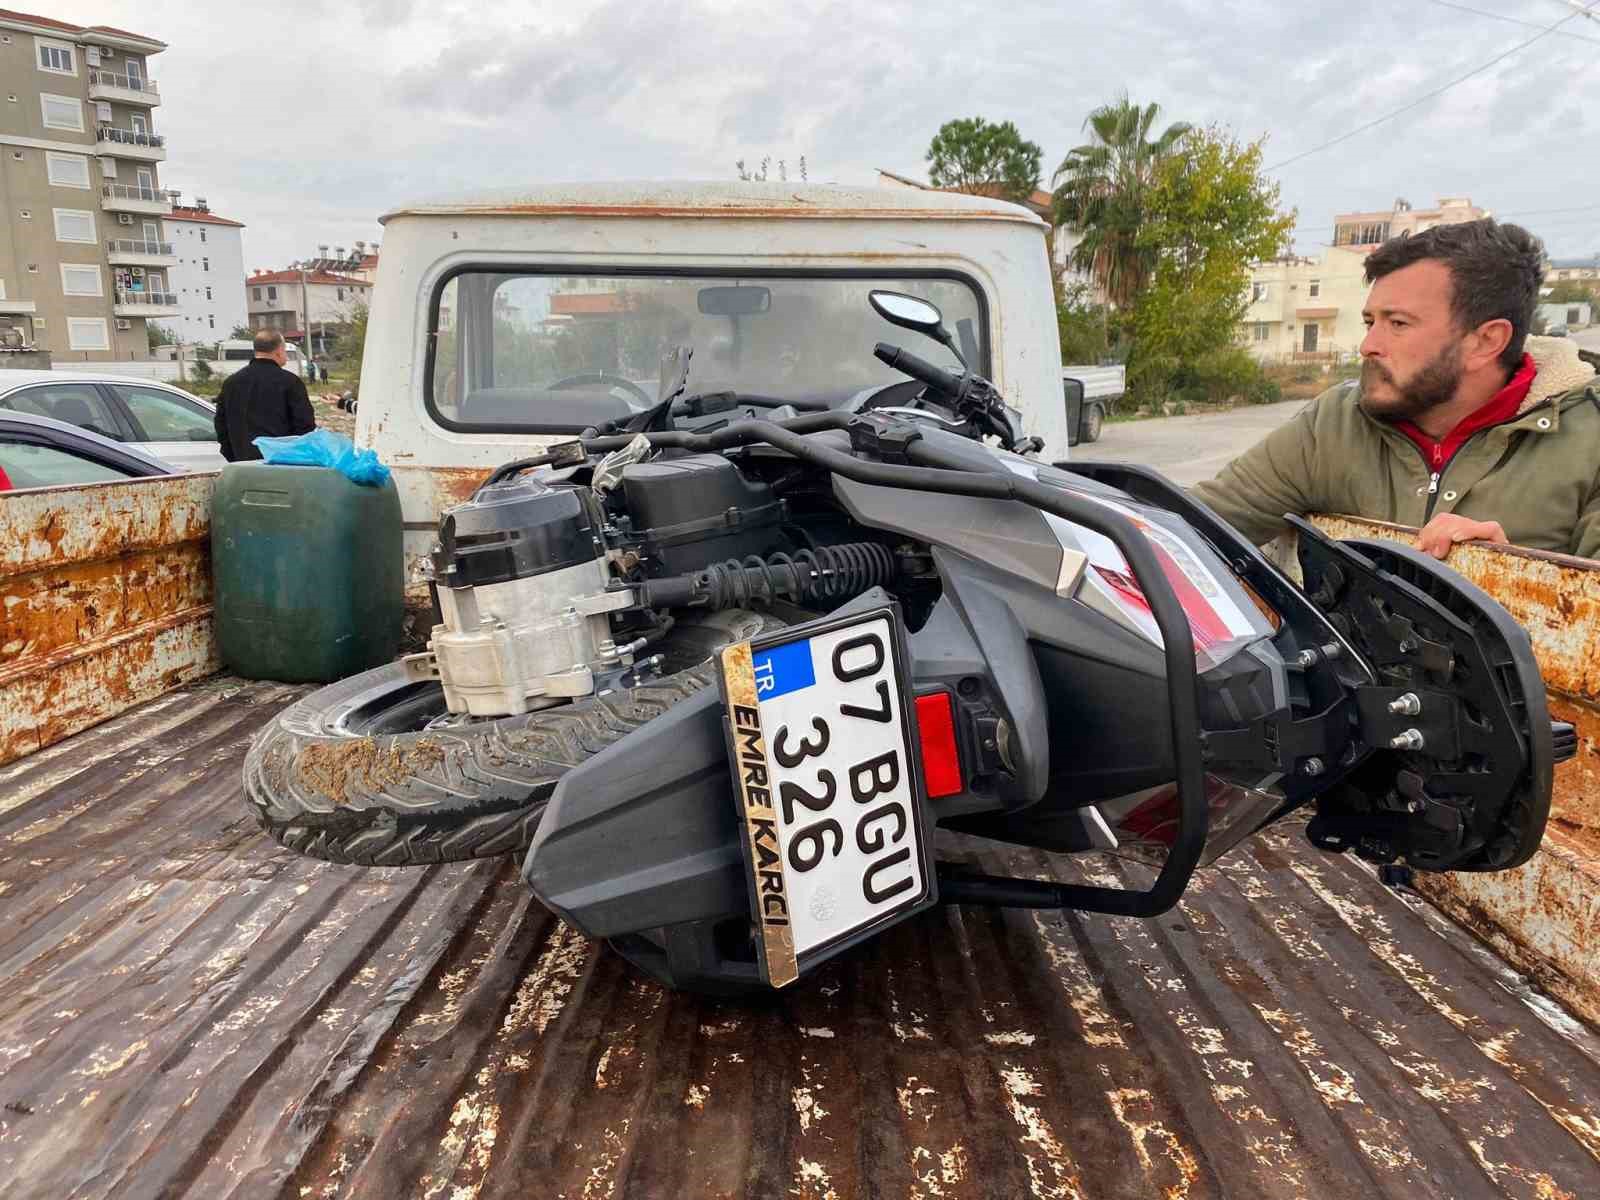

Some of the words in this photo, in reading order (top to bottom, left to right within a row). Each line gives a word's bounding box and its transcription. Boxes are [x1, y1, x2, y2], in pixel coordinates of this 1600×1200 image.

[755, 659, 774, 693] TR
[832, 632, 891, 722] 07
[733, 704, 771, 808] EMRE
[773, 716, 843, 873] 326
[750, 818, 787, 926] KARCI
[849, 749, 913, 904] BGU
